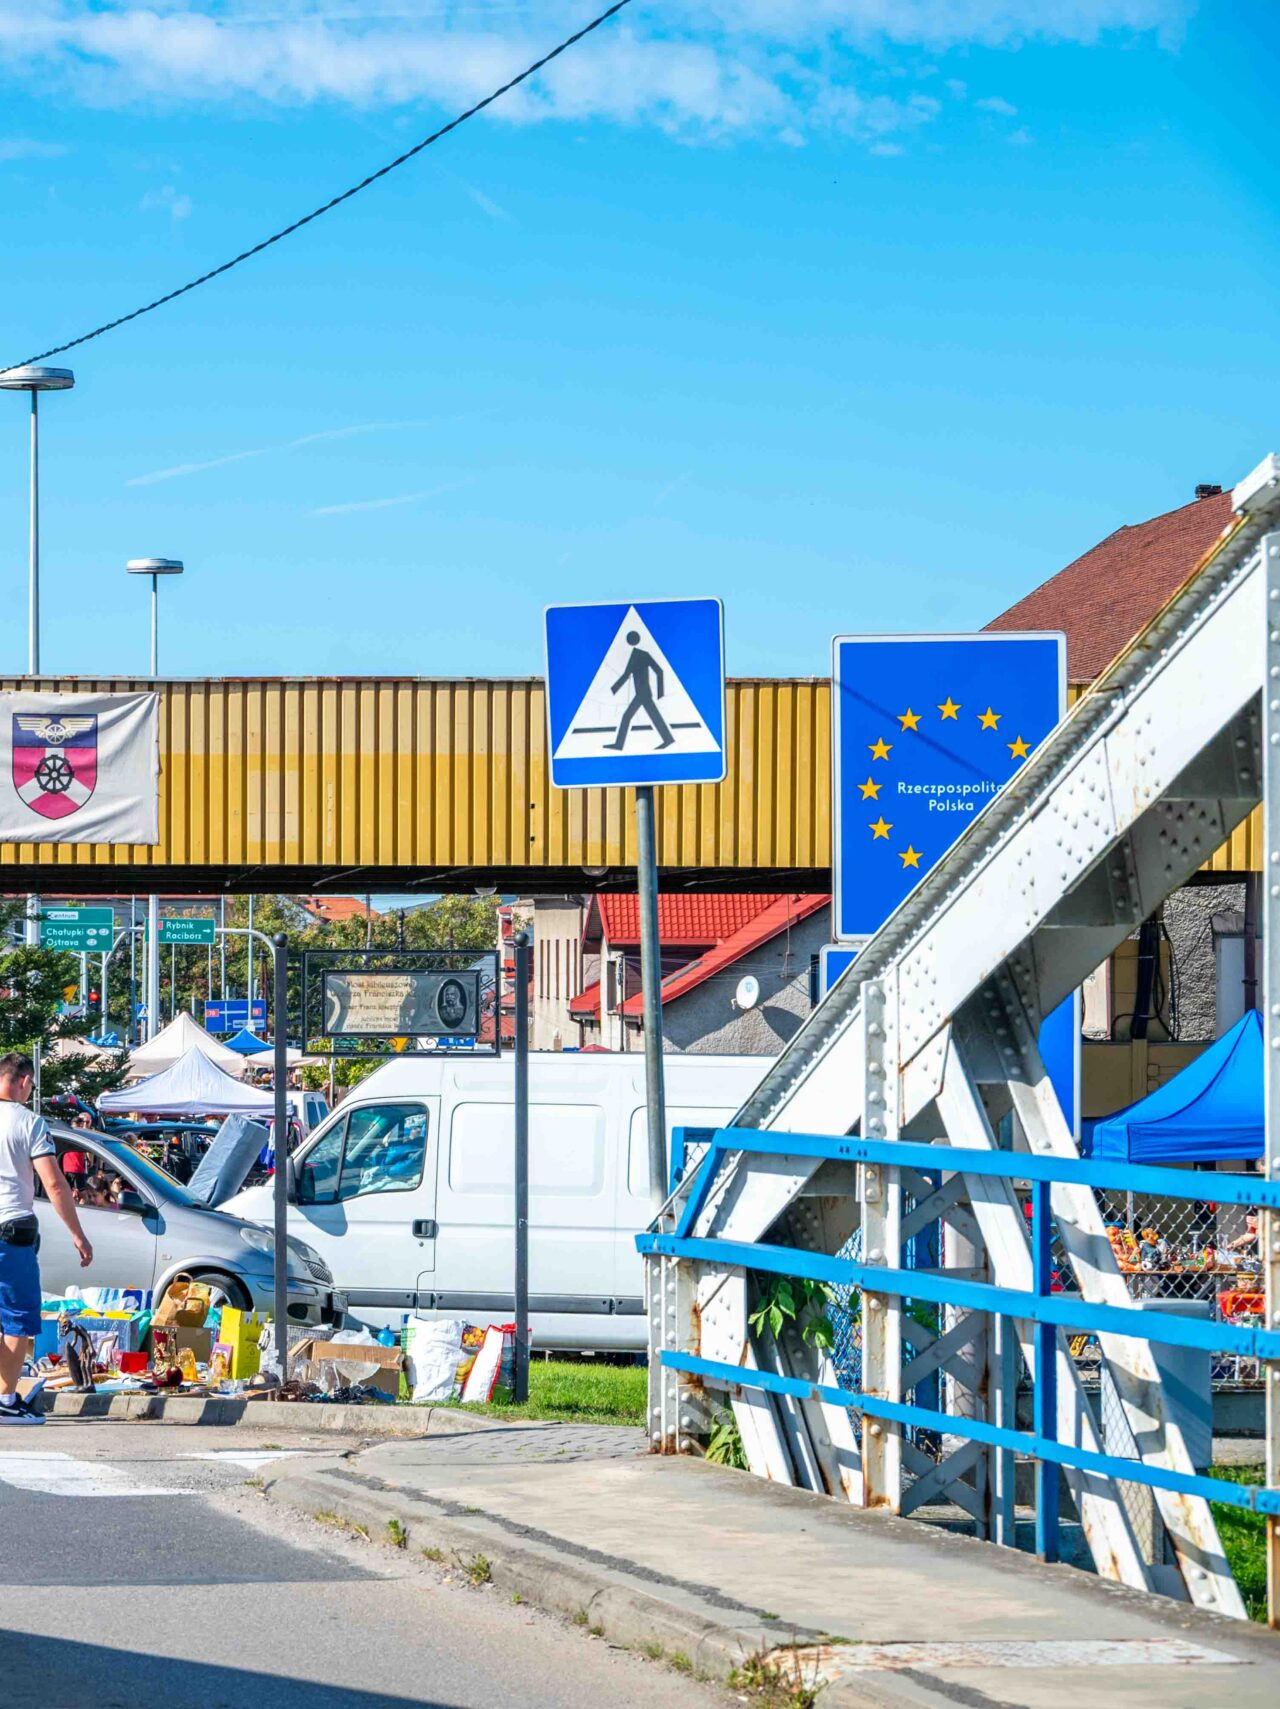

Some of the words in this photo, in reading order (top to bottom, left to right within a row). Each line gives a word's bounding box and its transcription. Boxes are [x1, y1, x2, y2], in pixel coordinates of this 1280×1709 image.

[928, 799, 974, 811] Polska
[166, 921, 194, 930] Rybnik
[46, 938, 79, 948] Ostrava
